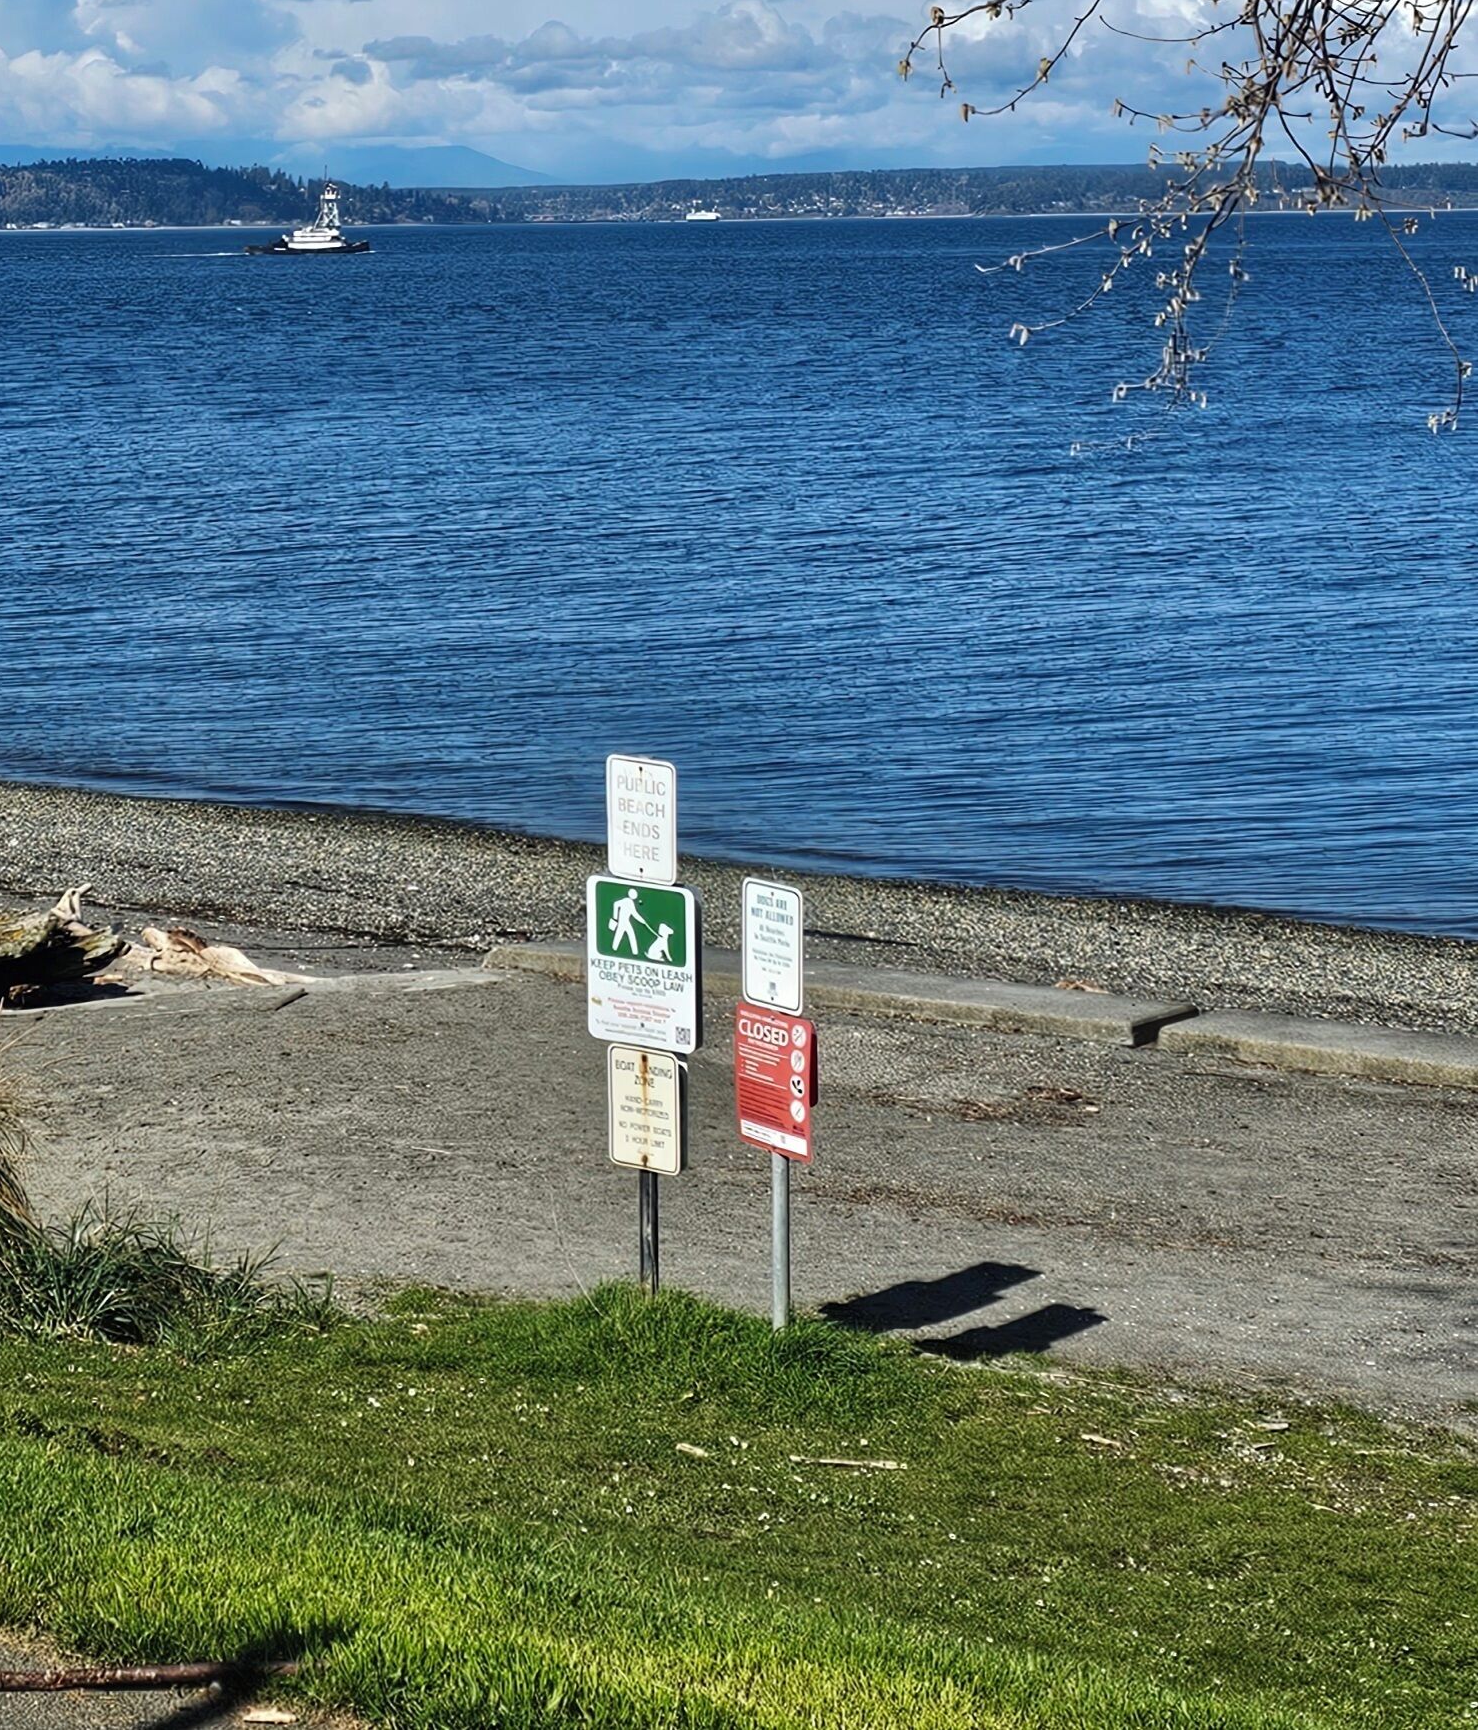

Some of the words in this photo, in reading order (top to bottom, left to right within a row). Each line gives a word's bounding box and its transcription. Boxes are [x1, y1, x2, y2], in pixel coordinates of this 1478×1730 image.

[617, 774, 666, 796] PUBLIC
[618, 797, 665, 818] BEACH
[623, 820, 660, 840] ENDS
[623, 842, 660, 862] HERE
[765, 910, 794, 926] ALLOWED
[591, 958, 615, 970] KEEP
[618, 962, 642, 975] PETS
[644, 967, 659, 977] ON
[662, 969, 693, 982] LEASH
[599, 971, 625, 983] OBEY
[627, 975, 661, 988] SCOOP
[663, 981, 684, 993] LAW
[738, 1019, 789, 1047] CLOSED
[615, 1059, 635, 1072] BOAT
[640, 1063, 672, 1079] ANDING
[635, 1075, 656, 1088] ZONE
